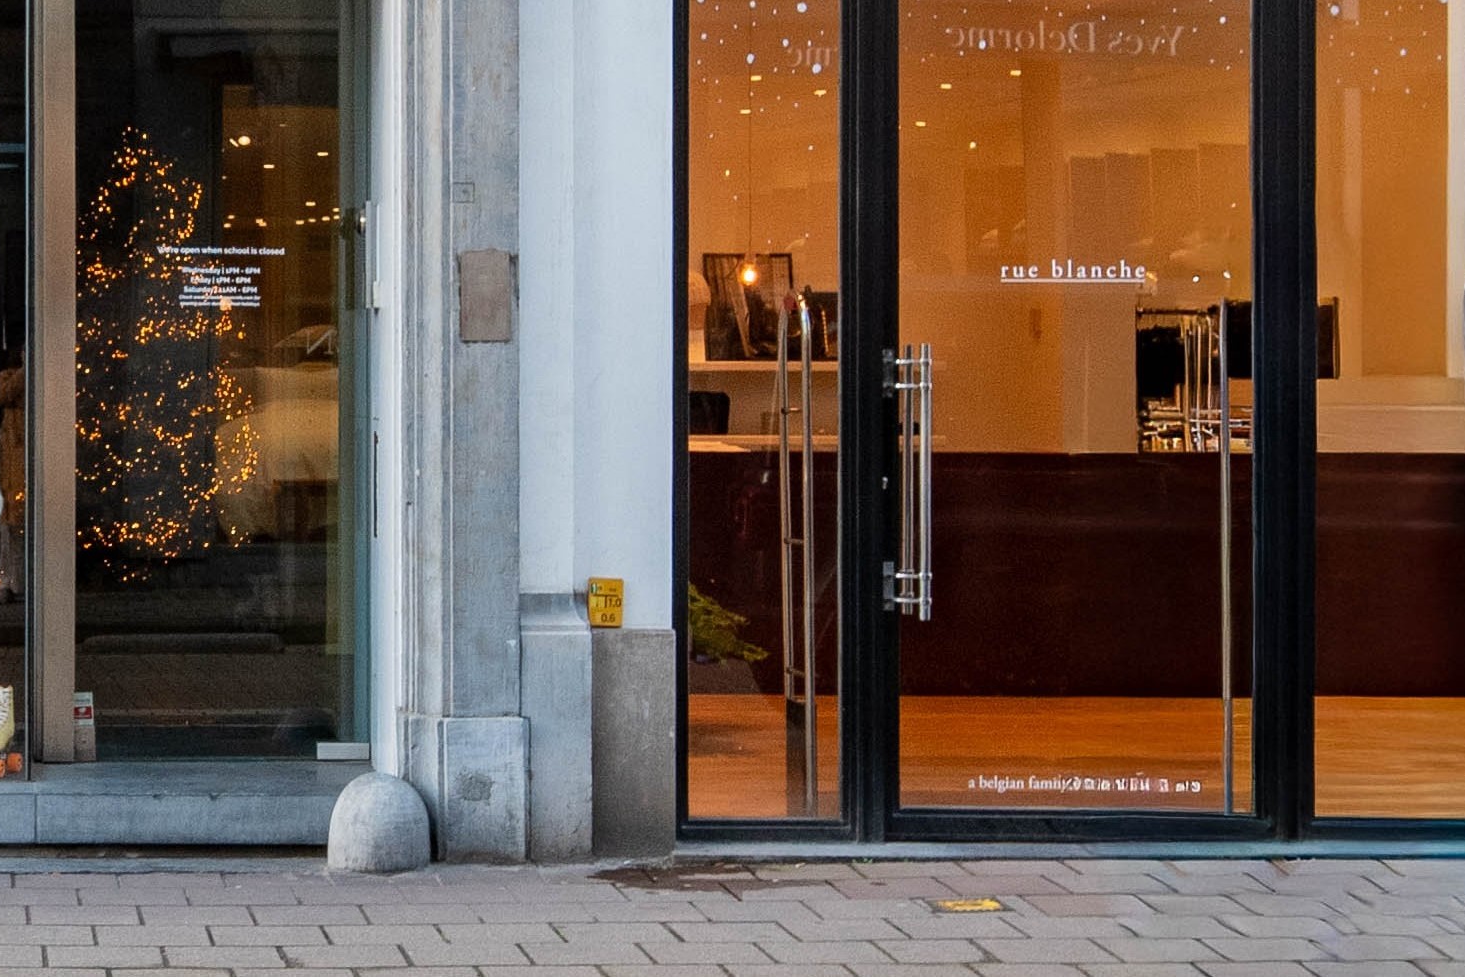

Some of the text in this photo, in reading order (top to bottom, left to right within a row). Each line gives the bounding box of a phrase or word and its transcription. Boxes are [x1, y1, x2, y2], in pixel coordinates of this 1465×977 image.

[180, 247, 200, 256] open
[202, 246, 223, 255] when
[224, 246, 250, 255] school
[251, 247, 257, 255] is
[258, 247, 285, 256] closed
[1000, 258, 1146, 279] rue blanche
[979, 775, 1025, 793] belgian
